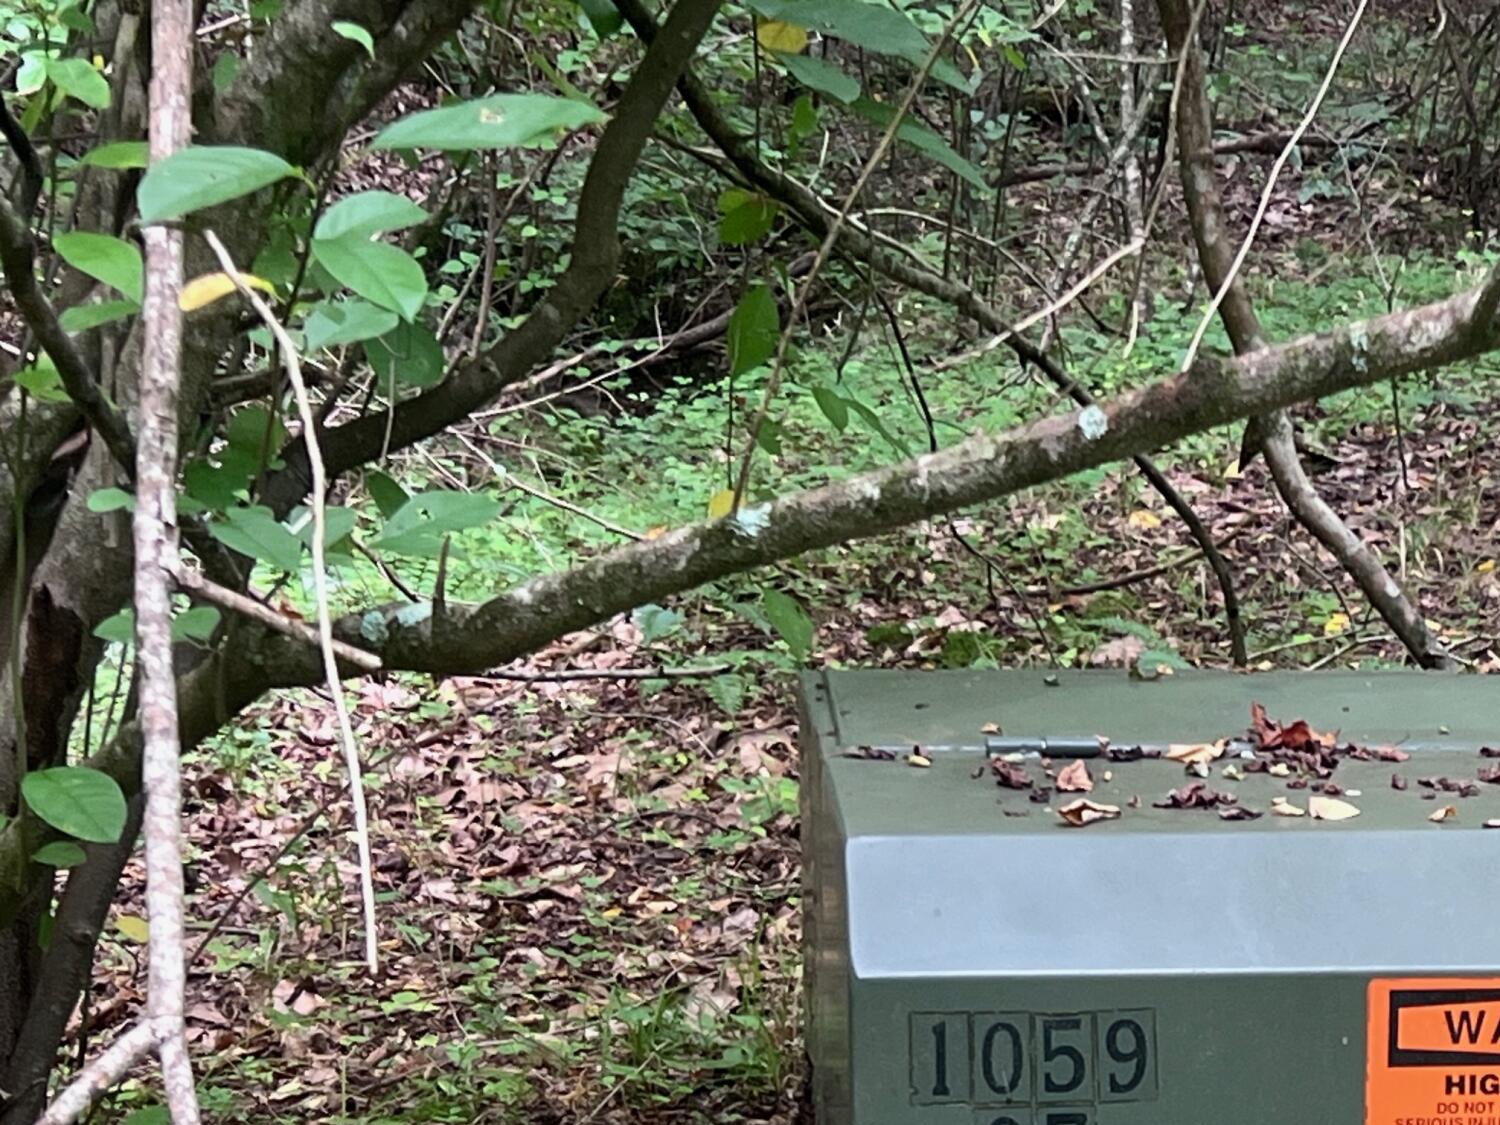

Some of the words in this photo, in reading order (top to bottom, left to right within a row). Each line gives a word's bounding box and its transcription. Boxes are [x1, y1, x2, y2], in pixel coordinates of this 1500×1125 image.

[931, 1017, 1148, 1097] 1059
[1437, 1102, 1459, 1114] DO
[1464, 1101, 1495, 1114] NOT
